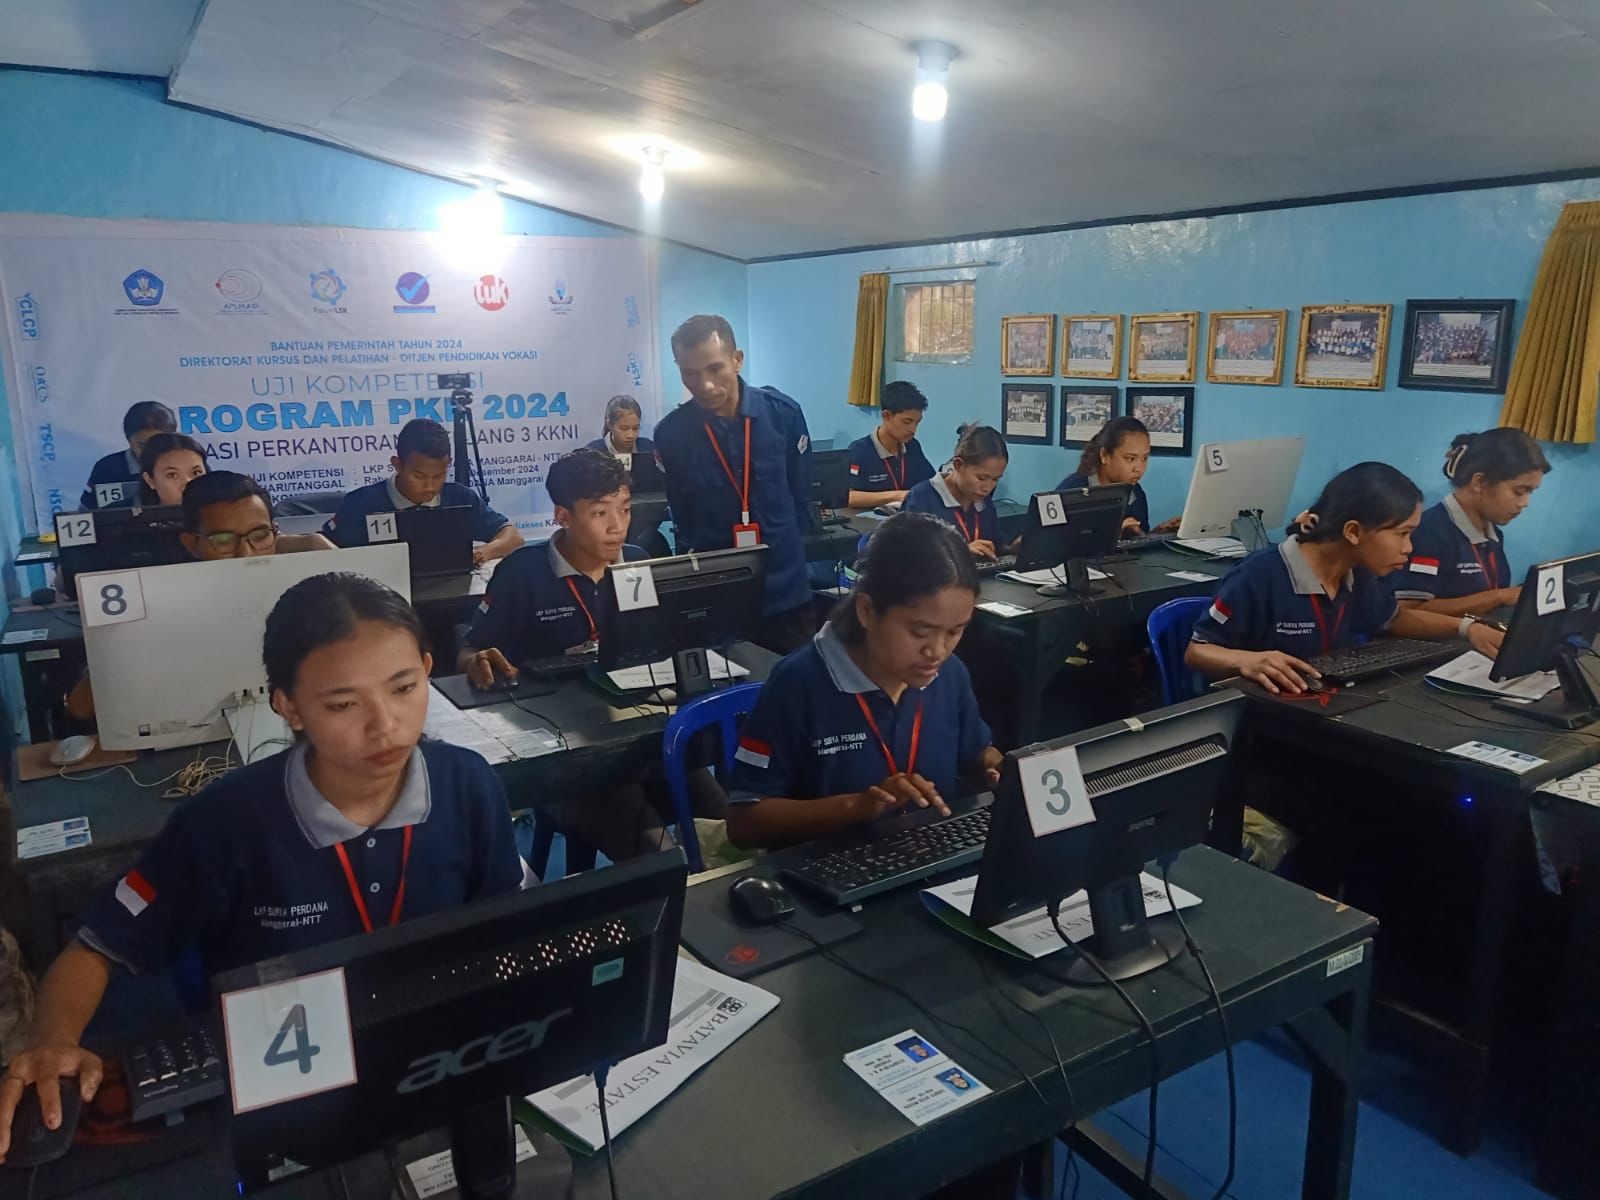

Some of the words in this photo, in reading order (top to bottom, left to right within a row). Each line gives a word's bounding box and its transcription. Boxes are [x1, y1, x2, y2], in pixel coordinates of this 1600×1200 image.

[271, 340, 323, 351] BANTUAN
[327, 340, 395, 350] PEMERINTAH
[399, 339, 432, 349] TAHUN
[436, 339, 463, 349] 2024
[179, 356, 252, 367] DIREKTORAT
[256, 355, 299, 366] KURSUS
[303, 354, 328, 364] DAN
[332, 353, 389, 364] PELATIHAN
[400, 352, 435, 362] DITJEN
[439, 351, 499, 361] PENDIDIKAN
[502, 350, 538, 360] VOKASI
[251, 376, 295, 396] UJI
[306, 371, 485, 395] KOMPETESI
[178, 399, 374, 434] ROGRAM
[482, 391, 570, 421] 2024
[521, 426, 530, 442] 3
[537, 424, 579, 441] KKNI
[1212, 449, 1223, 466] 5
[269, 468, 344, 482] KOMPETENSI
[363, 465, 384, 474] LKP
[518, 465, 539, 474] 2024
[497, 475, 544, 487] Manggarai
[100, 488, 122, 502] 15
[1045, 501, 1058, 520] 6
[61, 519, 93, 539] 12
[369, 517, 394, 536] 11
[625, 575, 642, 602] 7
[1545, 577, 1557, 605] 2
[100, 583, 128, 616] 8
[840, 732, 867, 743] PERDANA
[1041, 768, 1071, 816] 3
[290, 901, 329, 917] PERDANA
[263, 1003, 321, 1074] 4
[655, 1012, 729, 1067] BATAVIA
[397, 1007, 574, 1094] acer
